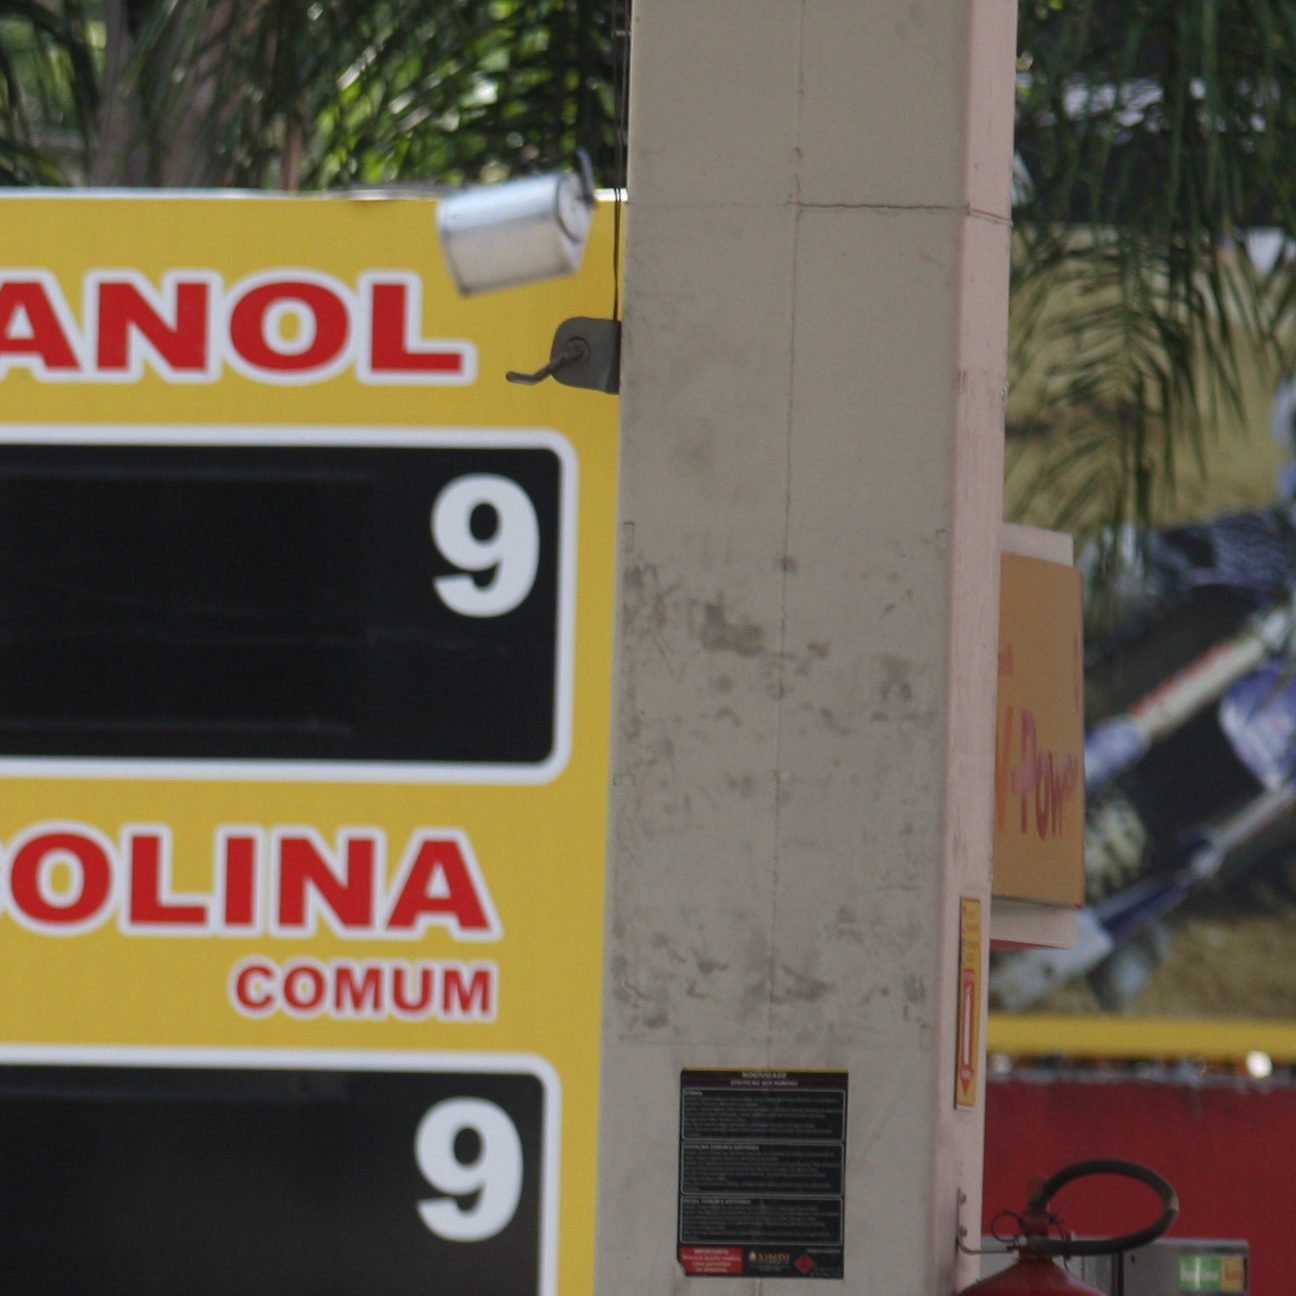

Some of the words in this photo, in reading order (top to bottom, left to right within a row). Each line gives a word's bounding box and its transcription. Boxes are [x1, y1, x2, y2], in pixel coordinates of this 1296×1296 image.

[430, 472, 542, 618] 9
[231, 959, 497, 1021] COMUM
[413, 1095, 525, 1243] 9
